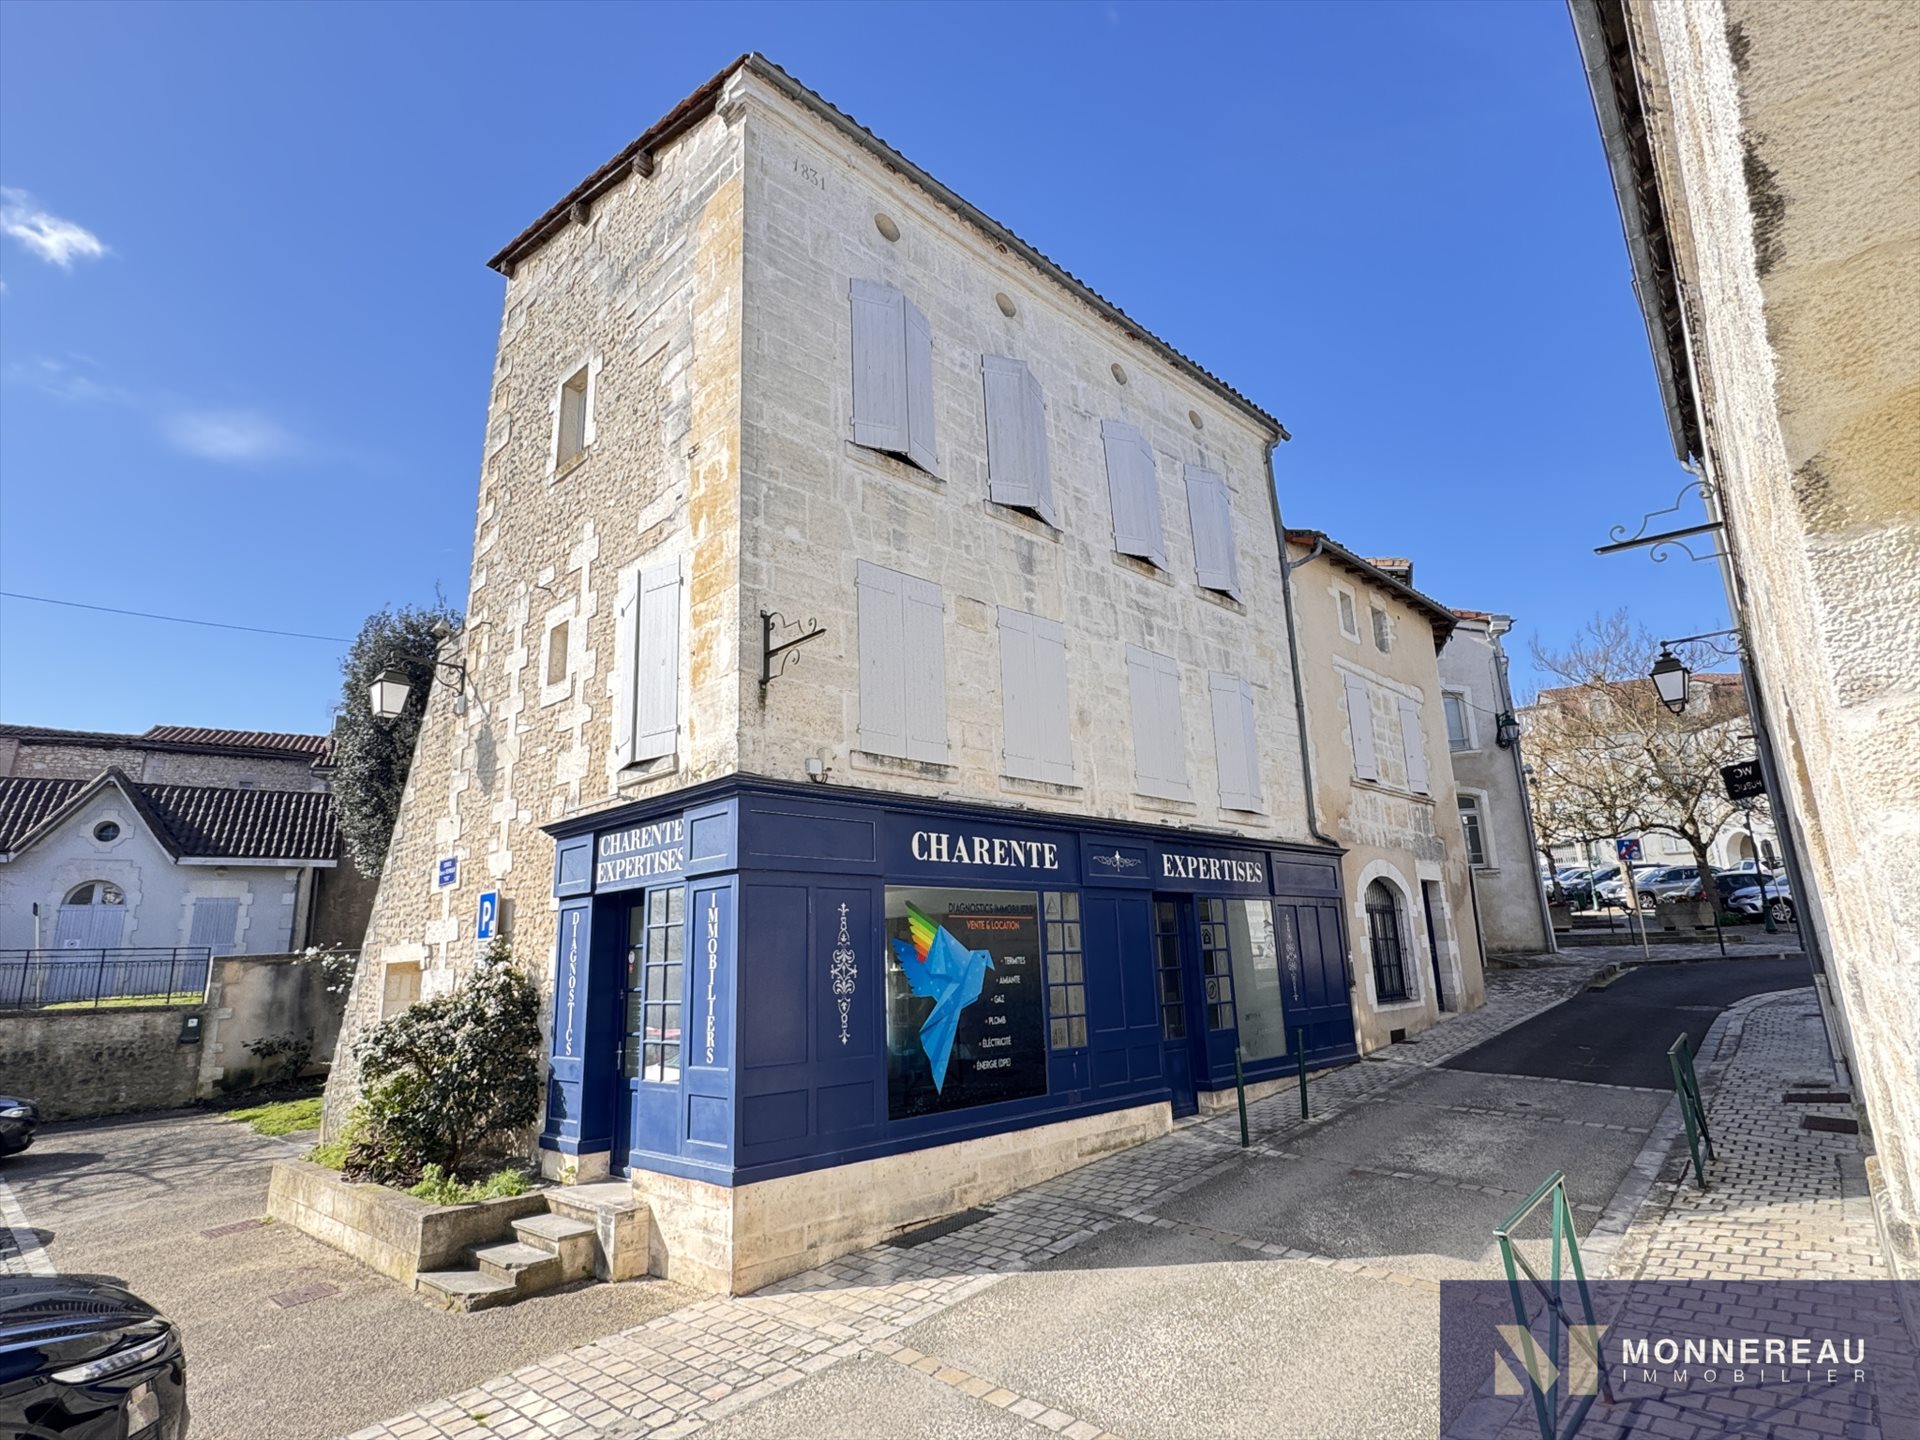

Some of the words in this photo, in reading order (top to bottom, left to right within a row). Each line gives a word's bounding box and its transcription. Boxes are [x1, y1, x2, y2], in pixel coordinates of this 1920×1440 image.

[792, 157, 826, 190] 1831
[600, 818, 684, 857] CHARENTE
[911, 830, 1059, 870] CHARENTE
[1161, 853, 1263, 884] EXPERTISES
[481, 900, 492, 932] P
[948, 903, 993, 913] DIAGNOSTICS
[966, 920, 984, 930] VENTE
[986, 921, 991, 930] &
[992, 921, 1020, 931] LOCATION
[1004, 956, 1026, 965] TERMITES
[566, 911, 580, 1057] DIAGNOSTICS
[707, 893, 719, 1064] IMMOBILIERS
[999, 975, 1021, 984] AMIANTE
[994, 994, 1005, 1004] GAZ
[988, 1015, 1007, 1025] PLOMB
